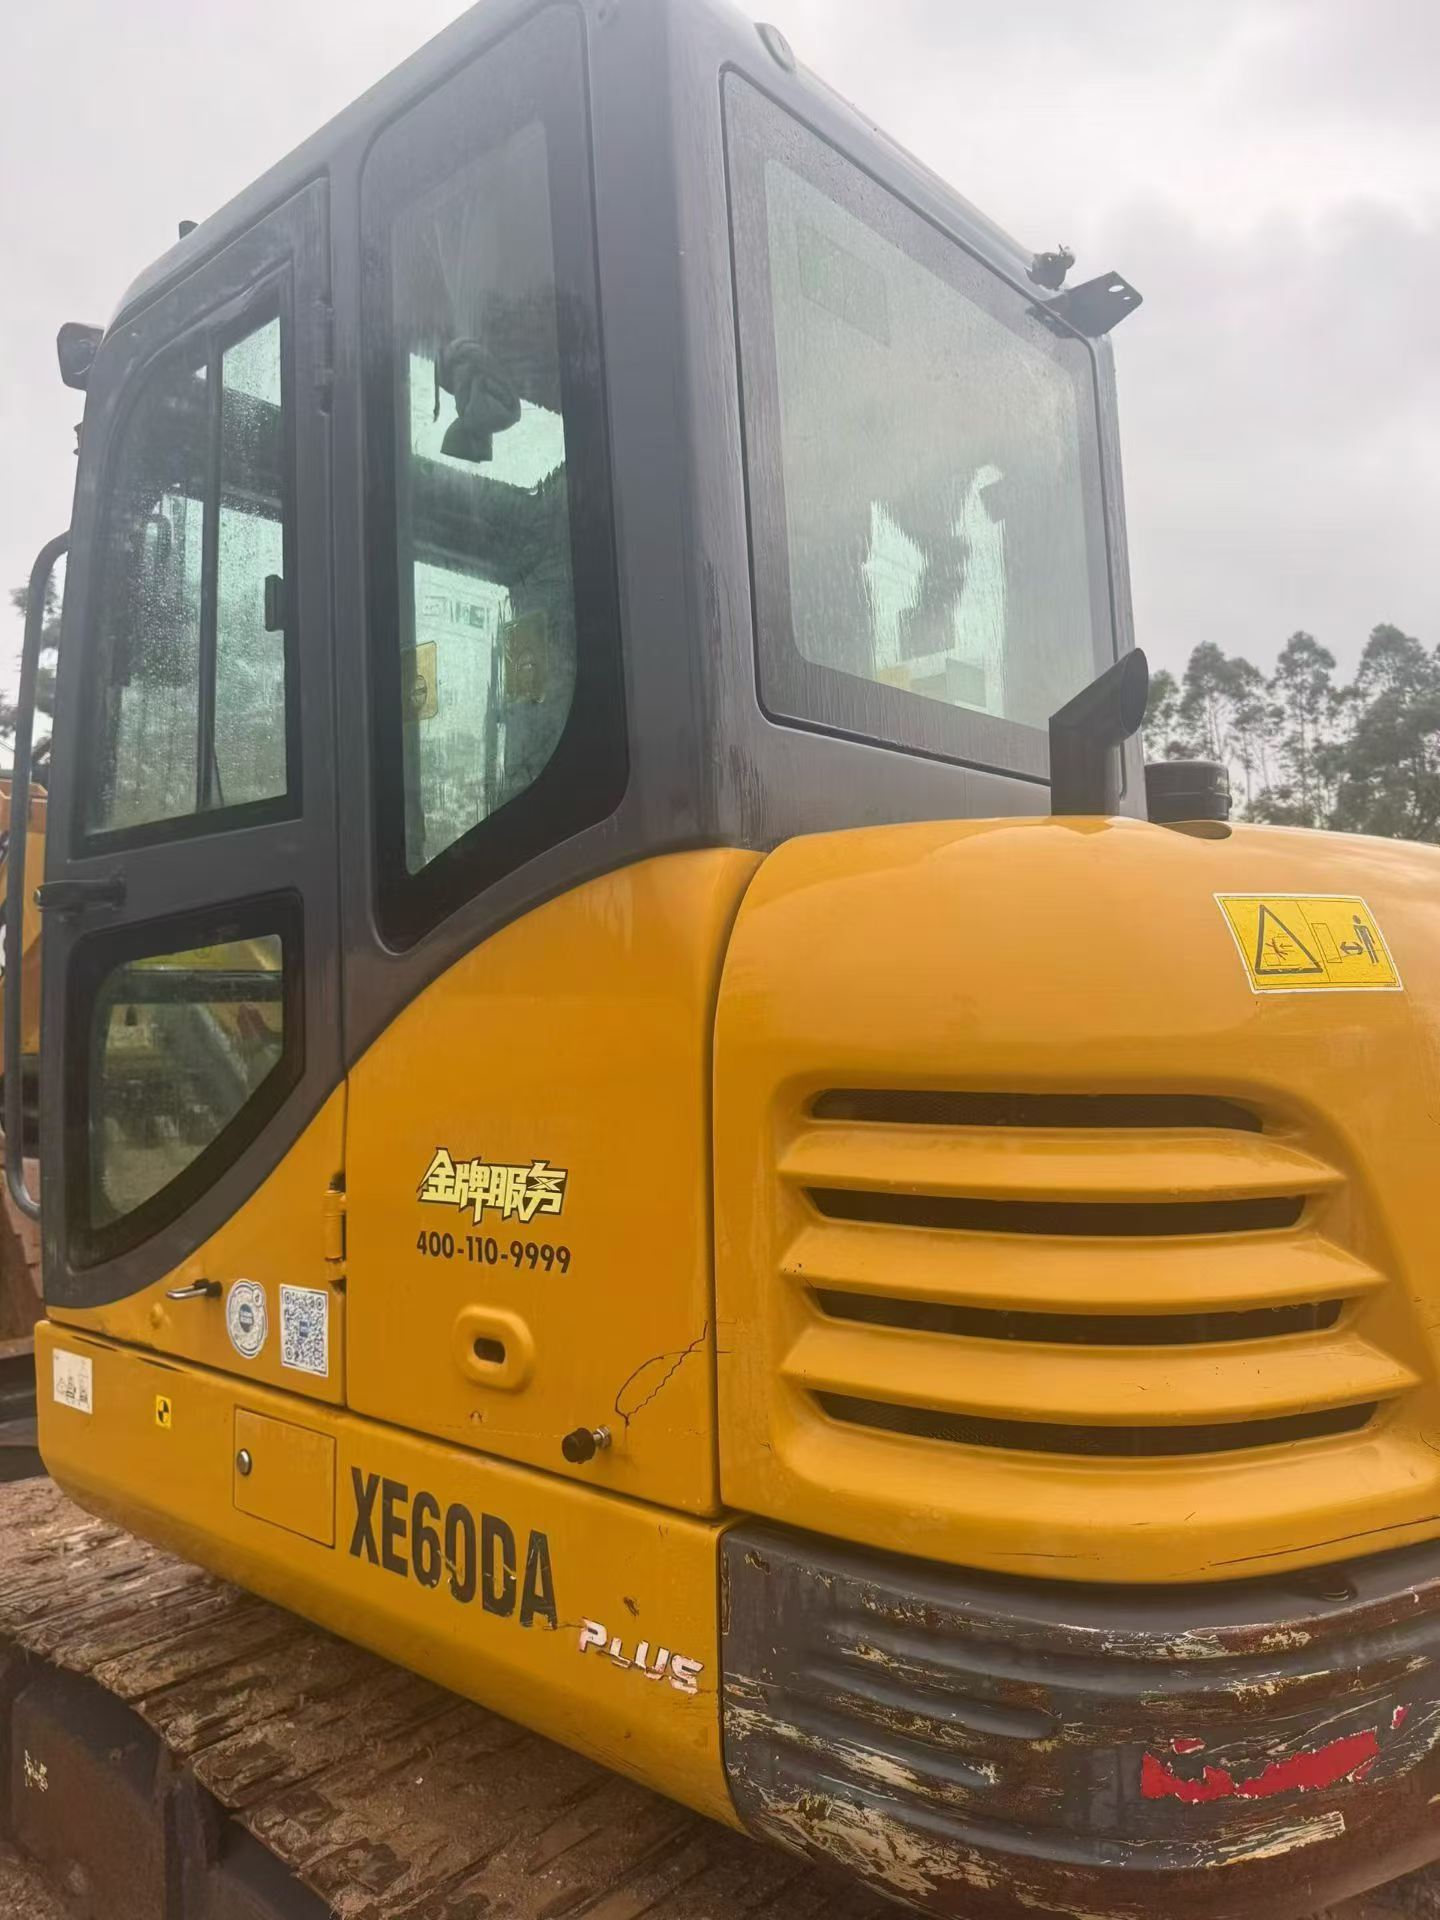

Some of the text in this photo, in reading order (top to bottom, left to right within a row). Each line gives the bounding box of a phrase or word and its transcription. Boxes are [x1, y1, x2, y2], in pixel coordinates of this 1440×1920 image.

[416, 1147, 568, 1226] 金牌服务
[416, 1230, 571, 1273] 400-110-9999
[349, 1466, 558, 1631] XE60DA
[577, 1617, 704, 1695] PLUS
